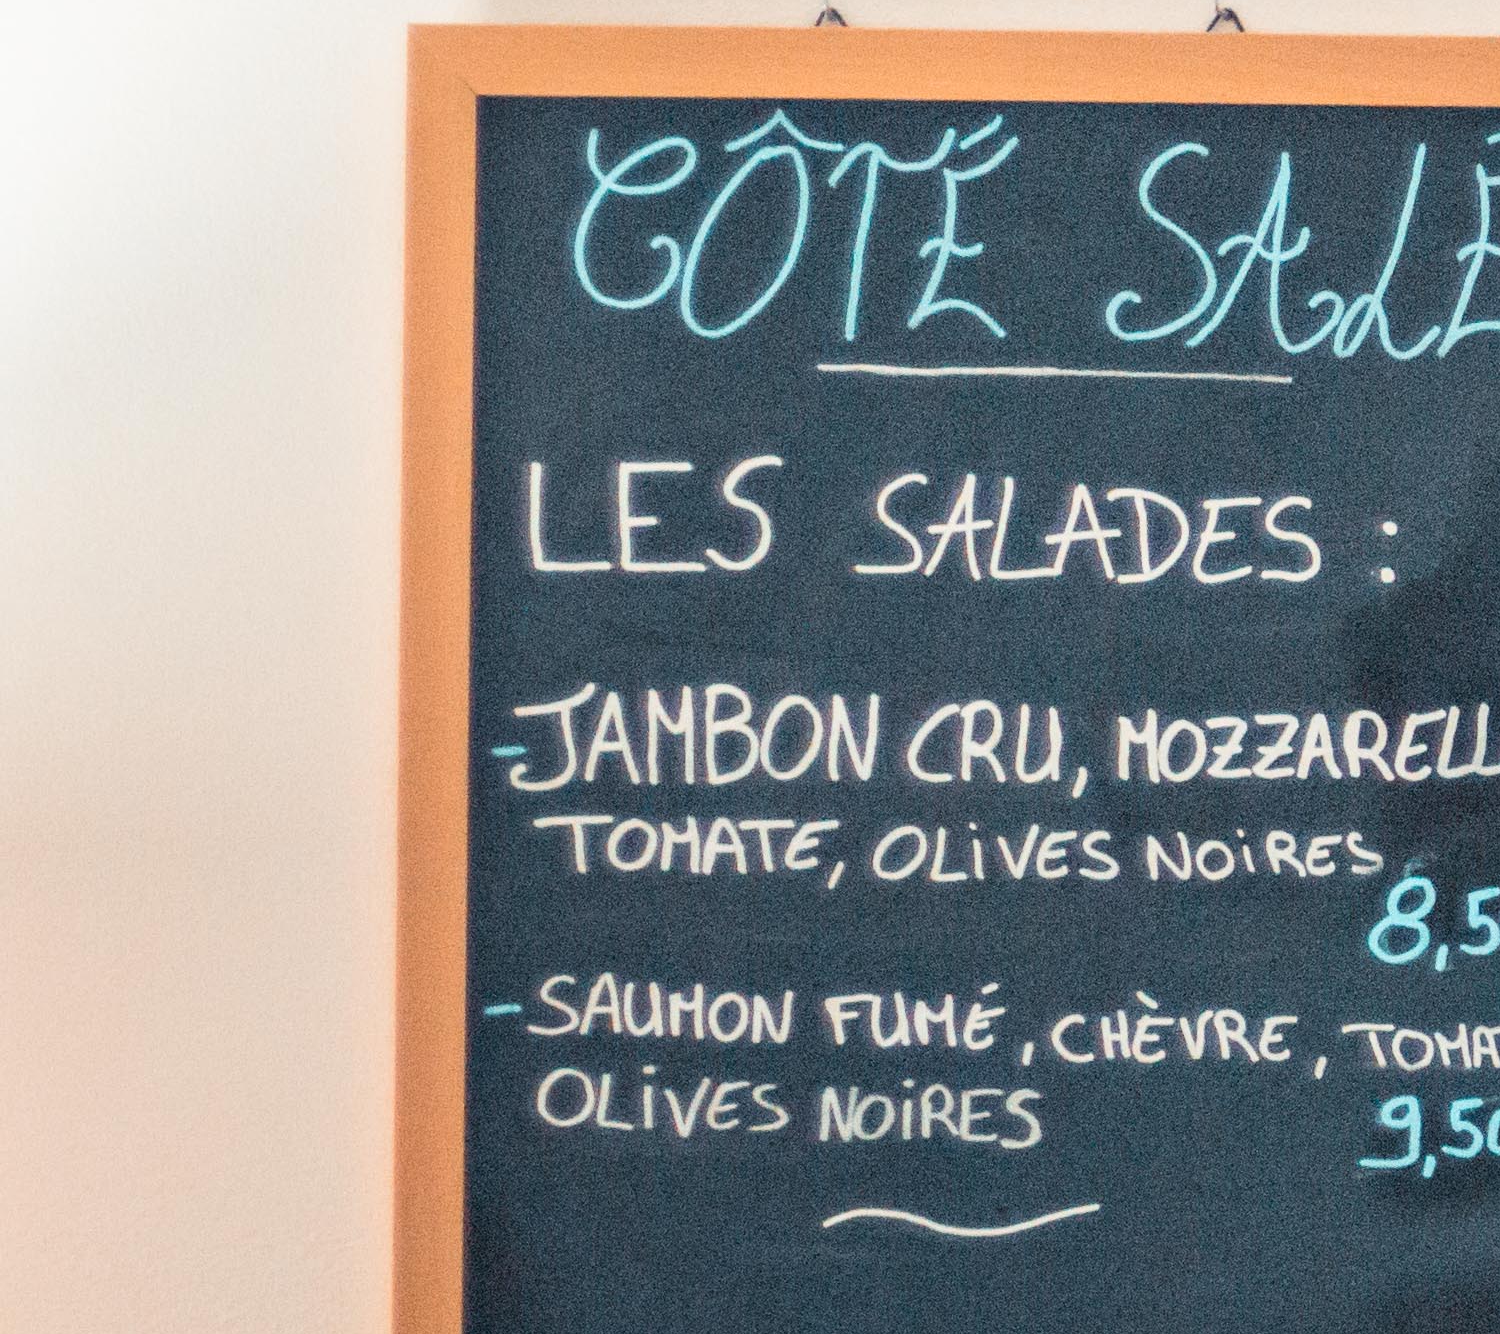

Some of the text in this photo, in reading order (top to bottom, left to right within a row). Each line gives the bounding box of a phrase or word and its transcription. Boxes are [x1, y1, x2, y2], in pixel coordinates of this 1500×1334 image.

[570, 109, 1020, 342] CÔTÉ
[526, 453, 784, 574] LES
[853, 471, 1322, 586] SALADES
[905, 698, 1089, 799] CRU,
[532, 813, 846, 890] TOMATE,
